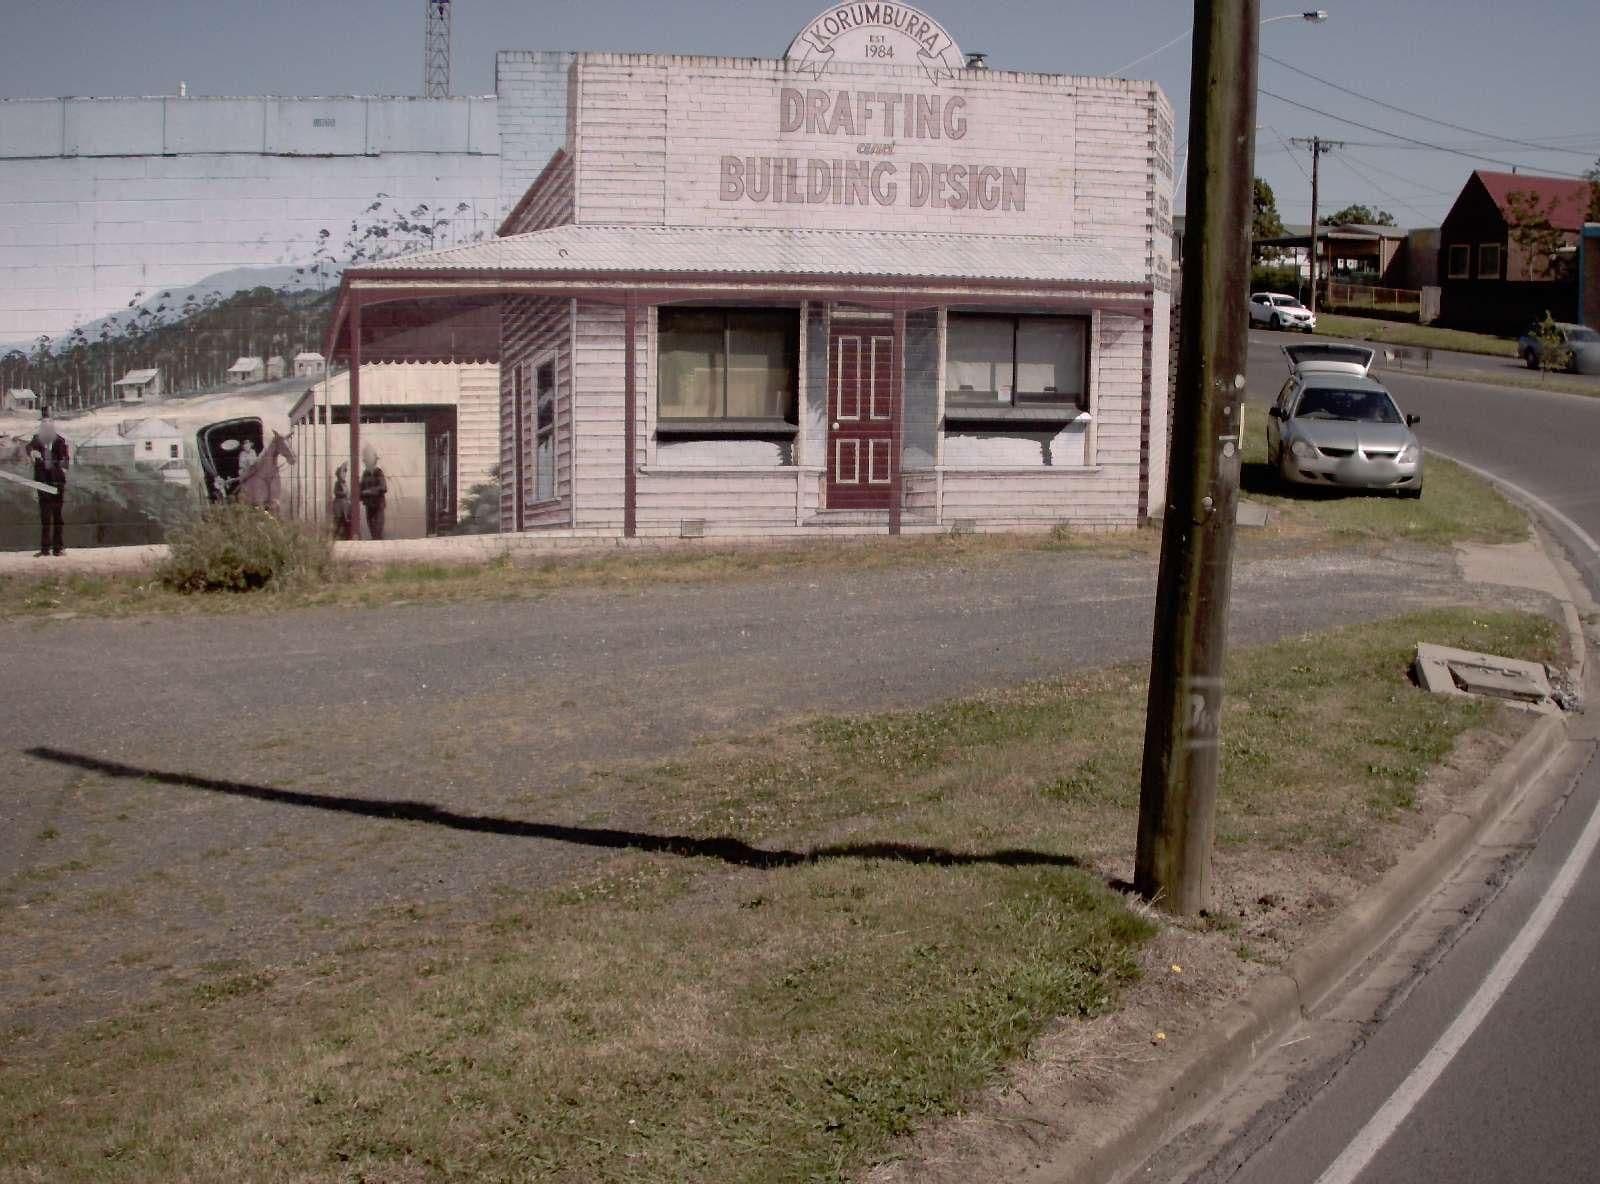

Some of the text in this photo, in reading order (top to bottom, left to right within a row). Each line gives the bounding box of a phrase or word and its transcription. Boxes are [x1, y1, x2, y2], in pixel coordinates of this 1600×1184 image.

[810, 4, 939, 51] KORUMBURRA
[865, 44, 895, 59] 1984
[780, 87, 967, 140] DRAFTING
[720, 155, 1026, 212] BUILDING DESIGN
